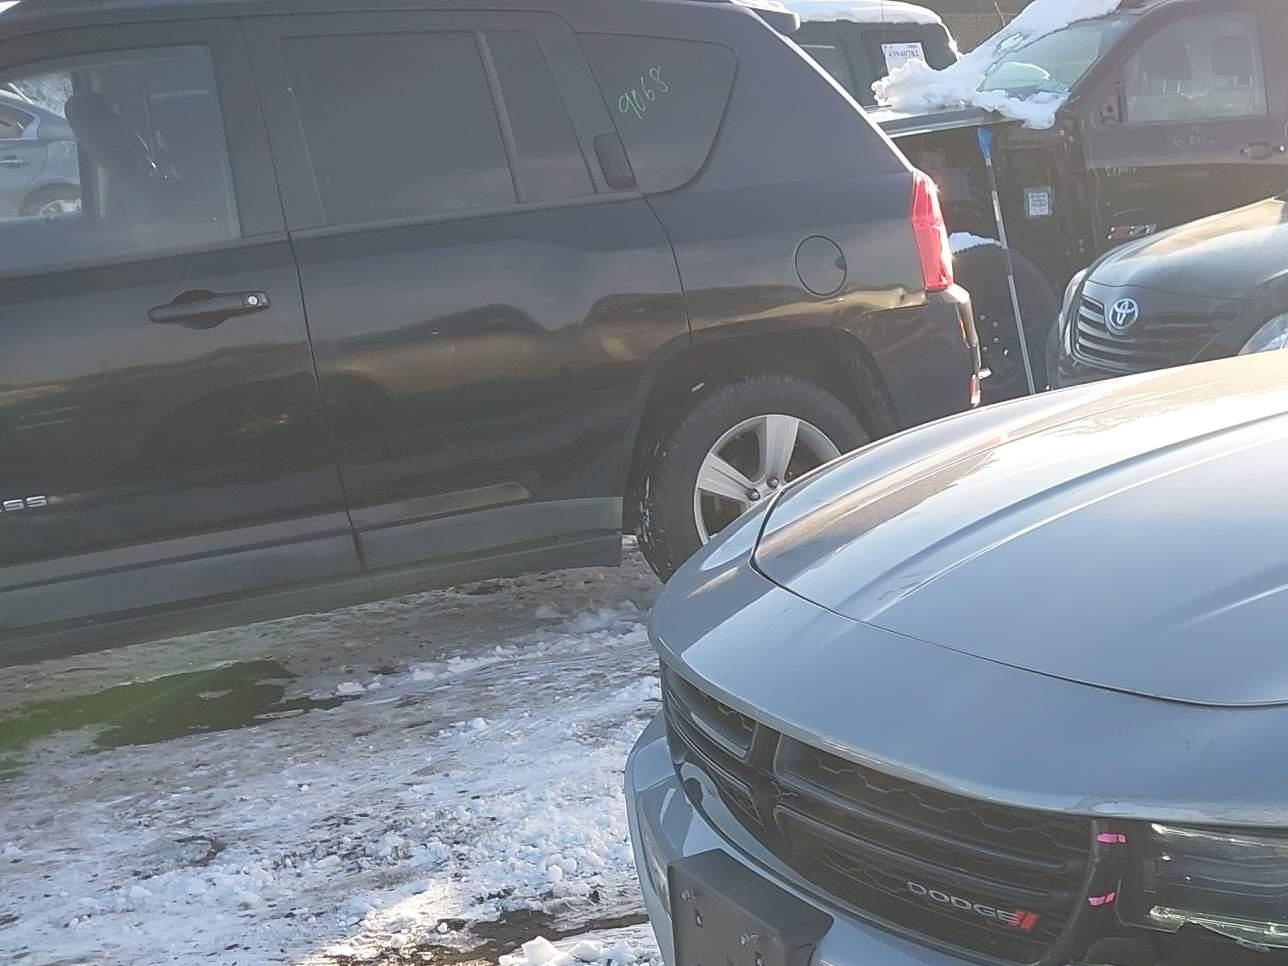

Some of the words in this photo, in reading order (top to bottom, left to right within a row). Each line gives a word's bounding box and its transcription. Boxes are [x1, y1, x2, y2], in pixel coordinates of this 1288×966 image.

[618, 64, 669, 119] 9068
[0, 495, 47, 512] SS
[906, 880, 1020, 925] DODGE
